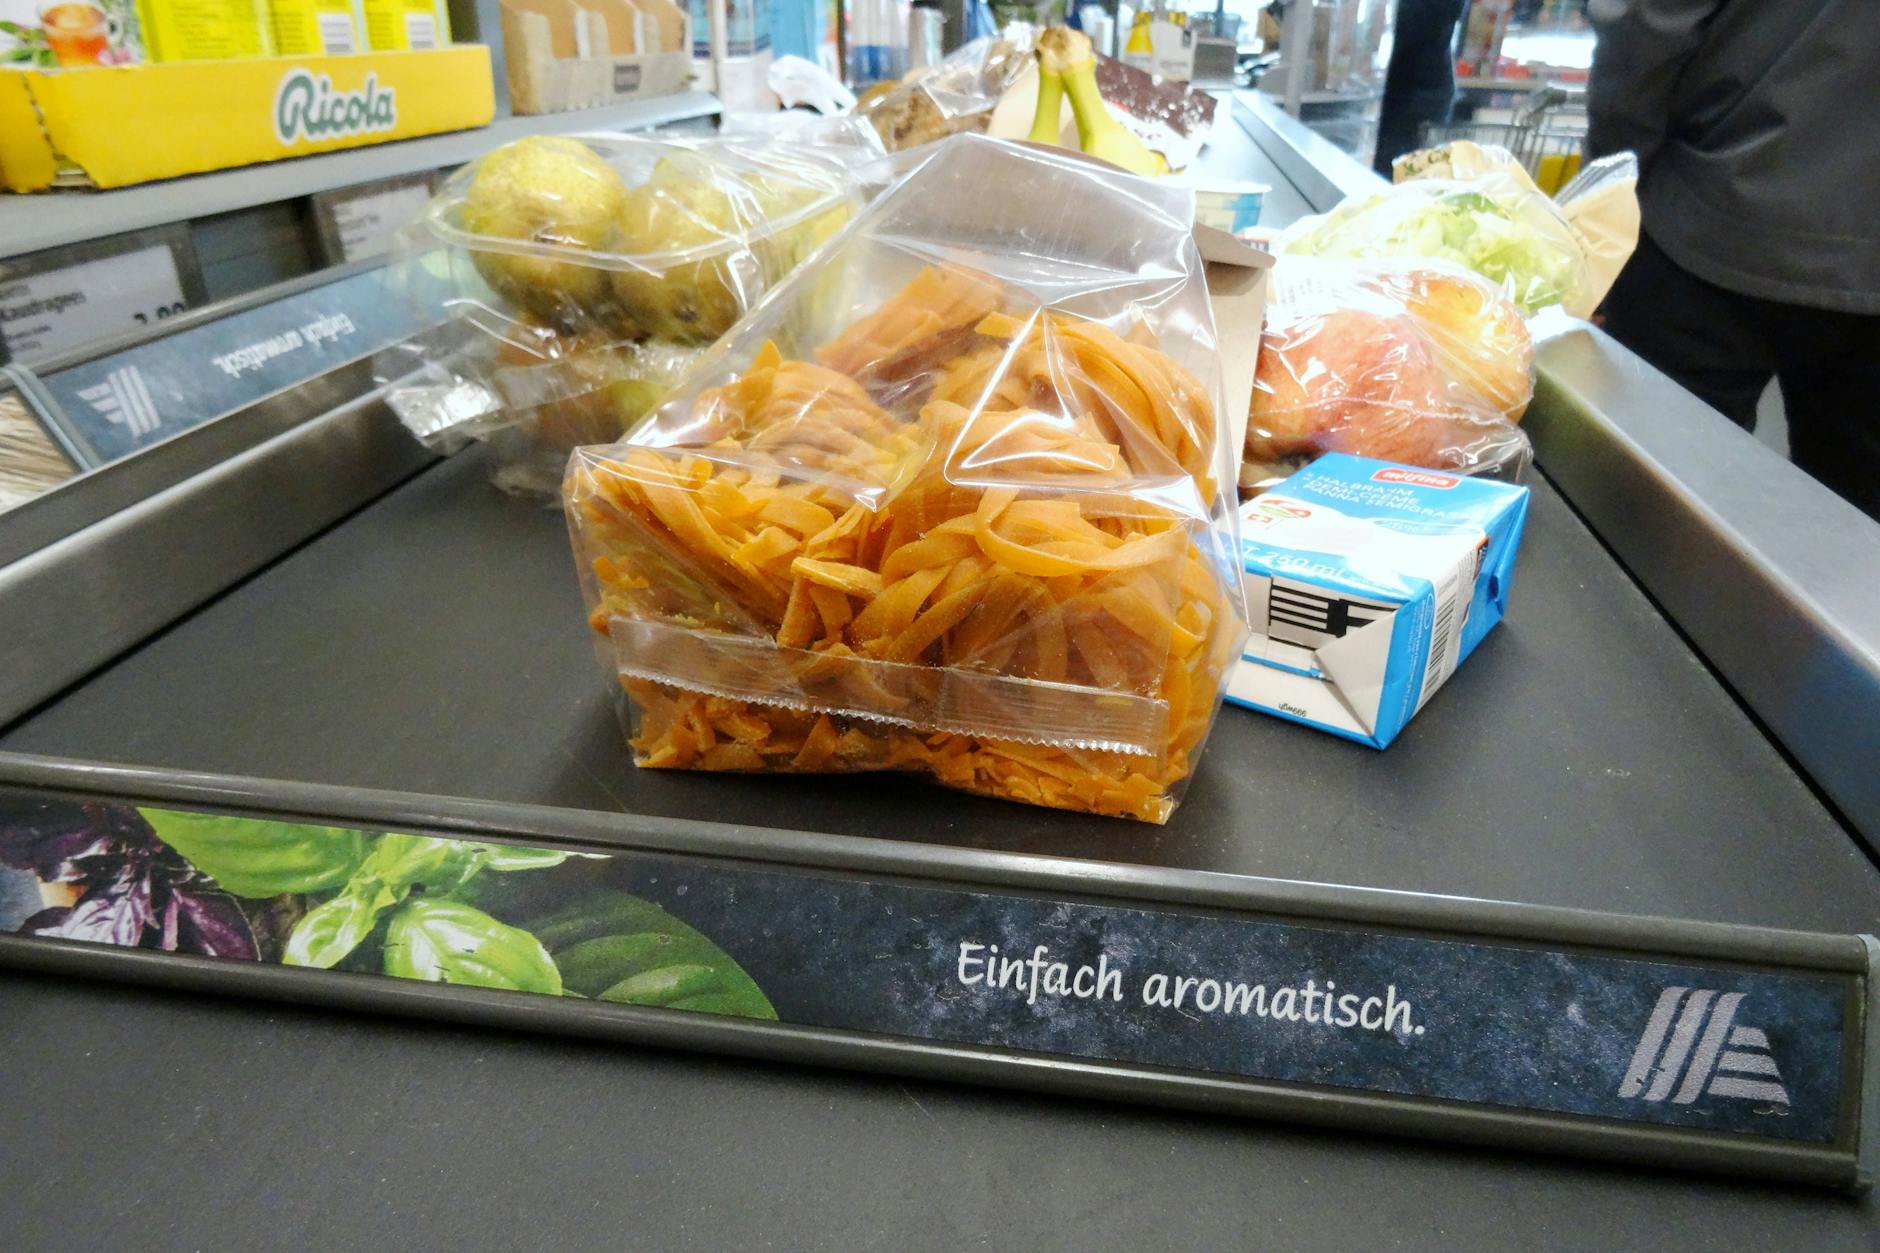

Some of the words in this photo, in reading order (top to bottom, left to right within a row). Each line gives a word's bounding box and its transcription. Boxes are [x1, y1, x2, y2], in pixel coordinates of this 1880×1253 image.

[276, 72, 395, 141] Ricola
[1382, 470, 1450, 488] milfina
[956, 941, 1124, 1005] Einfach
[1141, 973, 1427, 1036] aromatisch.
